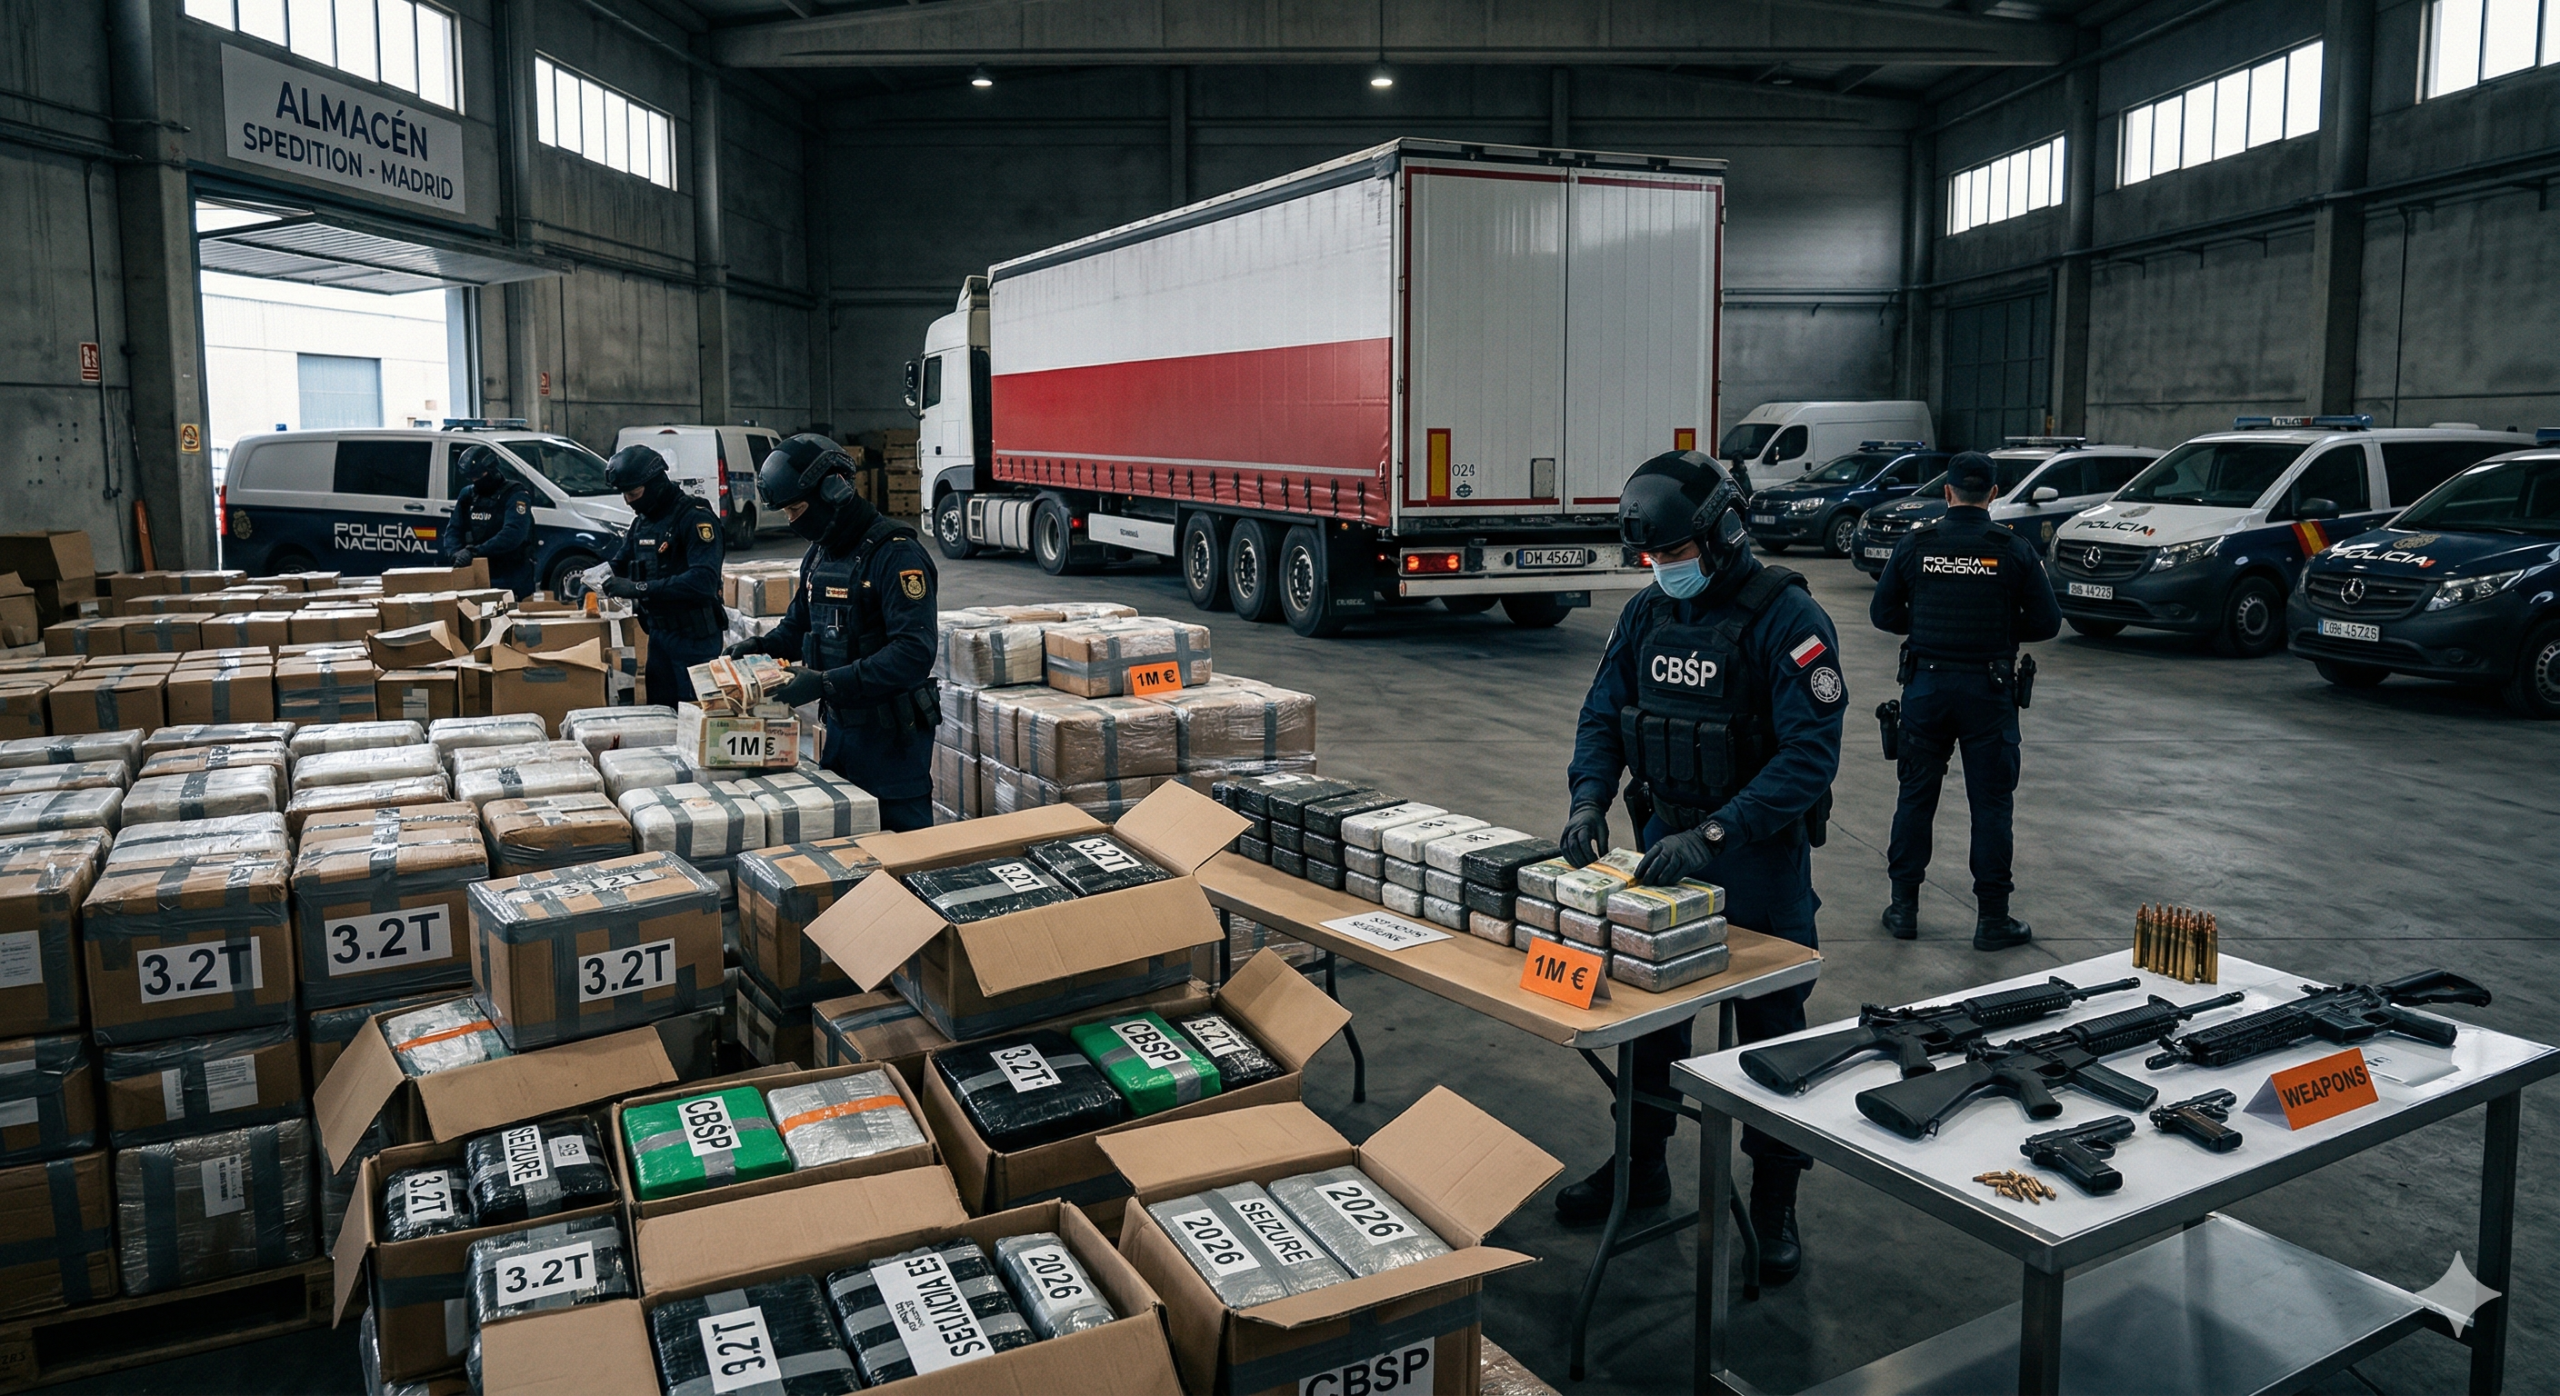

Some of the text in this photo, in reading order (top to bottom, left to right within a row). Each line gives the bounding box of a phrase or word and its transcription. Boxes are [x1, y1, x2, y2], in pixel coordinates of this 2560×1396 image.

[276, 81, 428, 161] ALMACÉN
[243, 122, 362, 177] SPEDITION
[381, 160, 454, 200] MADRID
[334, 522, 416, 539] POLICÍA
[335, 536, 438, 554] NACIONAL
[2074, 520, 2149, 535] POLICIA
[1547, 551, 1582, 564] 4567A
[1923, 556, 1981, 567] POLICÍA
[1923, 564, 1997, 575] NACIONAL
[2327, 549, 2429, 565] POLICIA
[1136, 669, 1175, 687] 1M €
[1651, 650, 1717, 687] CBŚP
[727, 737, 760, 756] 1M
[1079, 841, 1135, 868] 3.2T
[998, 866, 1041, 889] 3.2T
[332, 912, 440, 964] 3.2T
[142, 943, 251, 995] 3.2T
[584, 944, 671, 994] 3.2T
[1535, 955, 1588, 990] 1M €
[1190, 1021, 1241, 1050] 3.2T
[1000, 1049, 1053, 1085] 3.2T
[2282, 1065, 2367, 1108] WEAPONS
[508, 1128, 542, 1182] SEIZURE
[409, 1176, 447, 1214] 3.2T
[1326, 1186, 1404, 1237] 2026
[1183, 1217, 1244, 1264] 2026
[1240, 1202, 1313, 1262] SEIZURE
[505, 1253, 590, 1293] 3.2T
[1028, 1254, 1082, 1300] 2026
